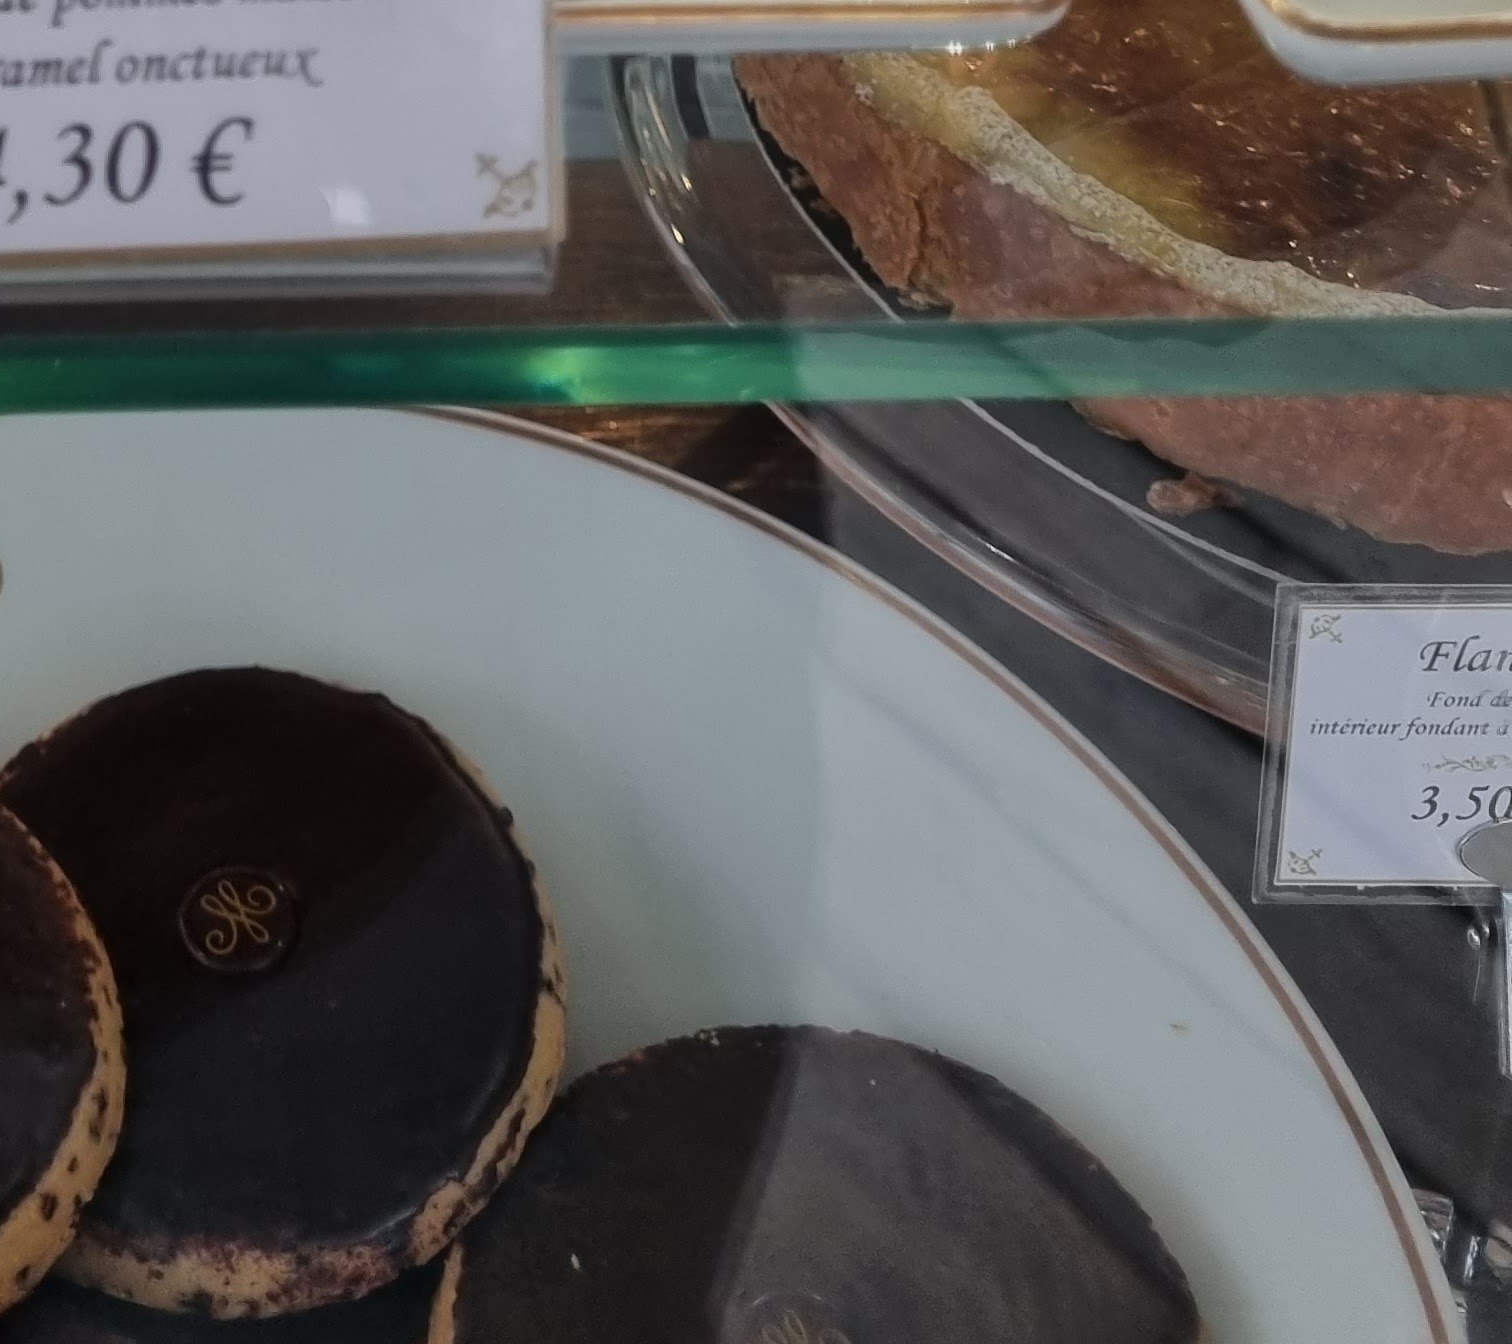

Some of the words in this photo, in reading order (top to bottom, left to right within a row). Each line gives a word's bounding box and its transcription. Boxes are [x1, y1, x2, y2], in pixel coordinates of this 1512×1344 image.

[114, 47, 321, 86] onctueux
[190, 116, 256, 207] €
[1426, 690, 1492, 708] Fond
[1310, 717, 1401, 736] intérieur
[1398, 716, 1490, 741] fondant
